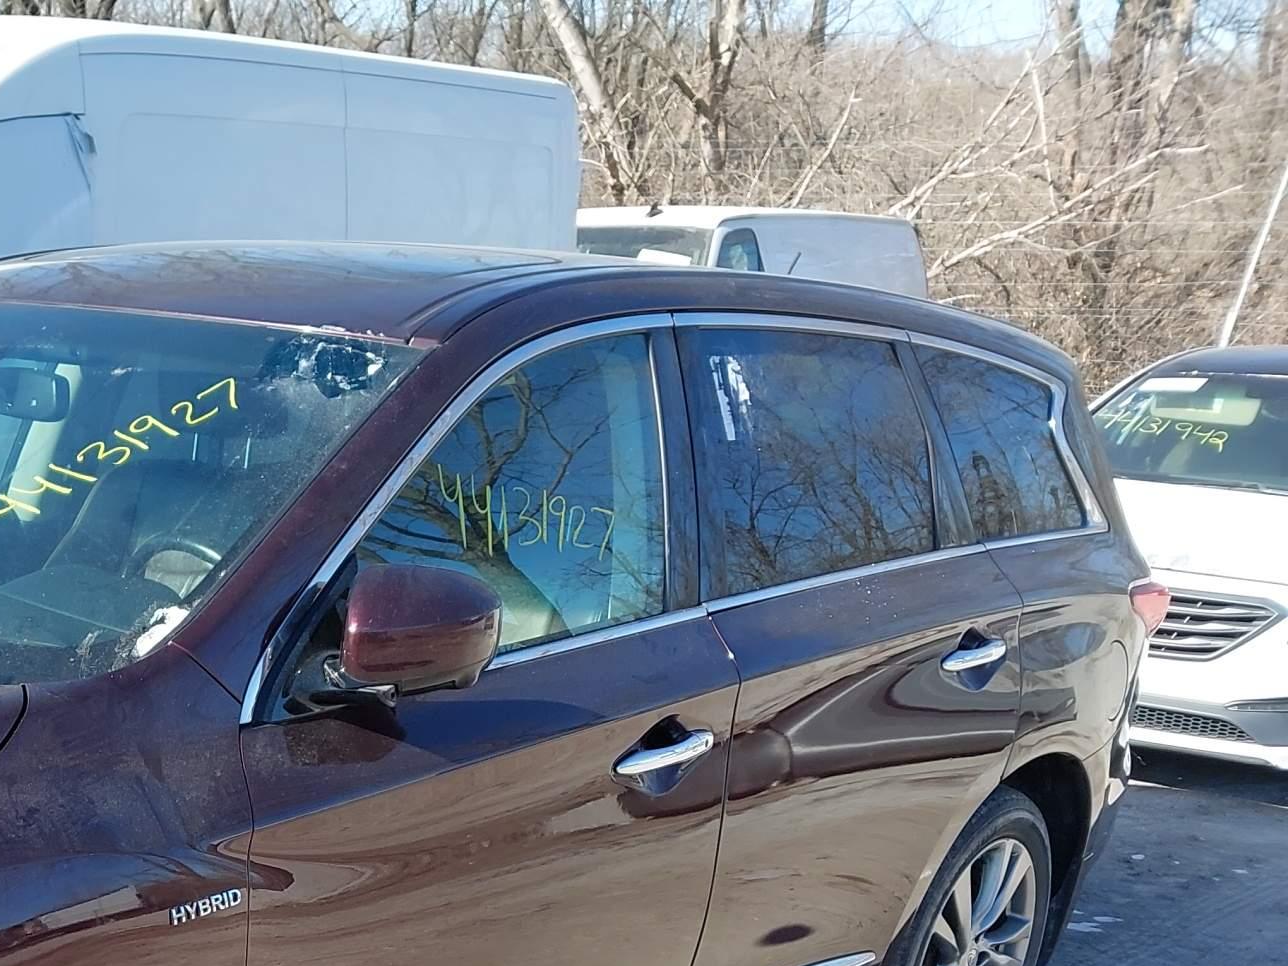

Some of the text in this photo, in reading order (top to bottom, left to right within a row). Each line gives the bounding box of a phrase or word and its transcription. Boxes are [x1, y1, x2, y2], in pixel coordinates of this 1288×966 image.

[1097, 408, 1230, 453] 44131942
[437, 463, 615, 560] 44131927
[170, 888, 242, 926] HYBRID
